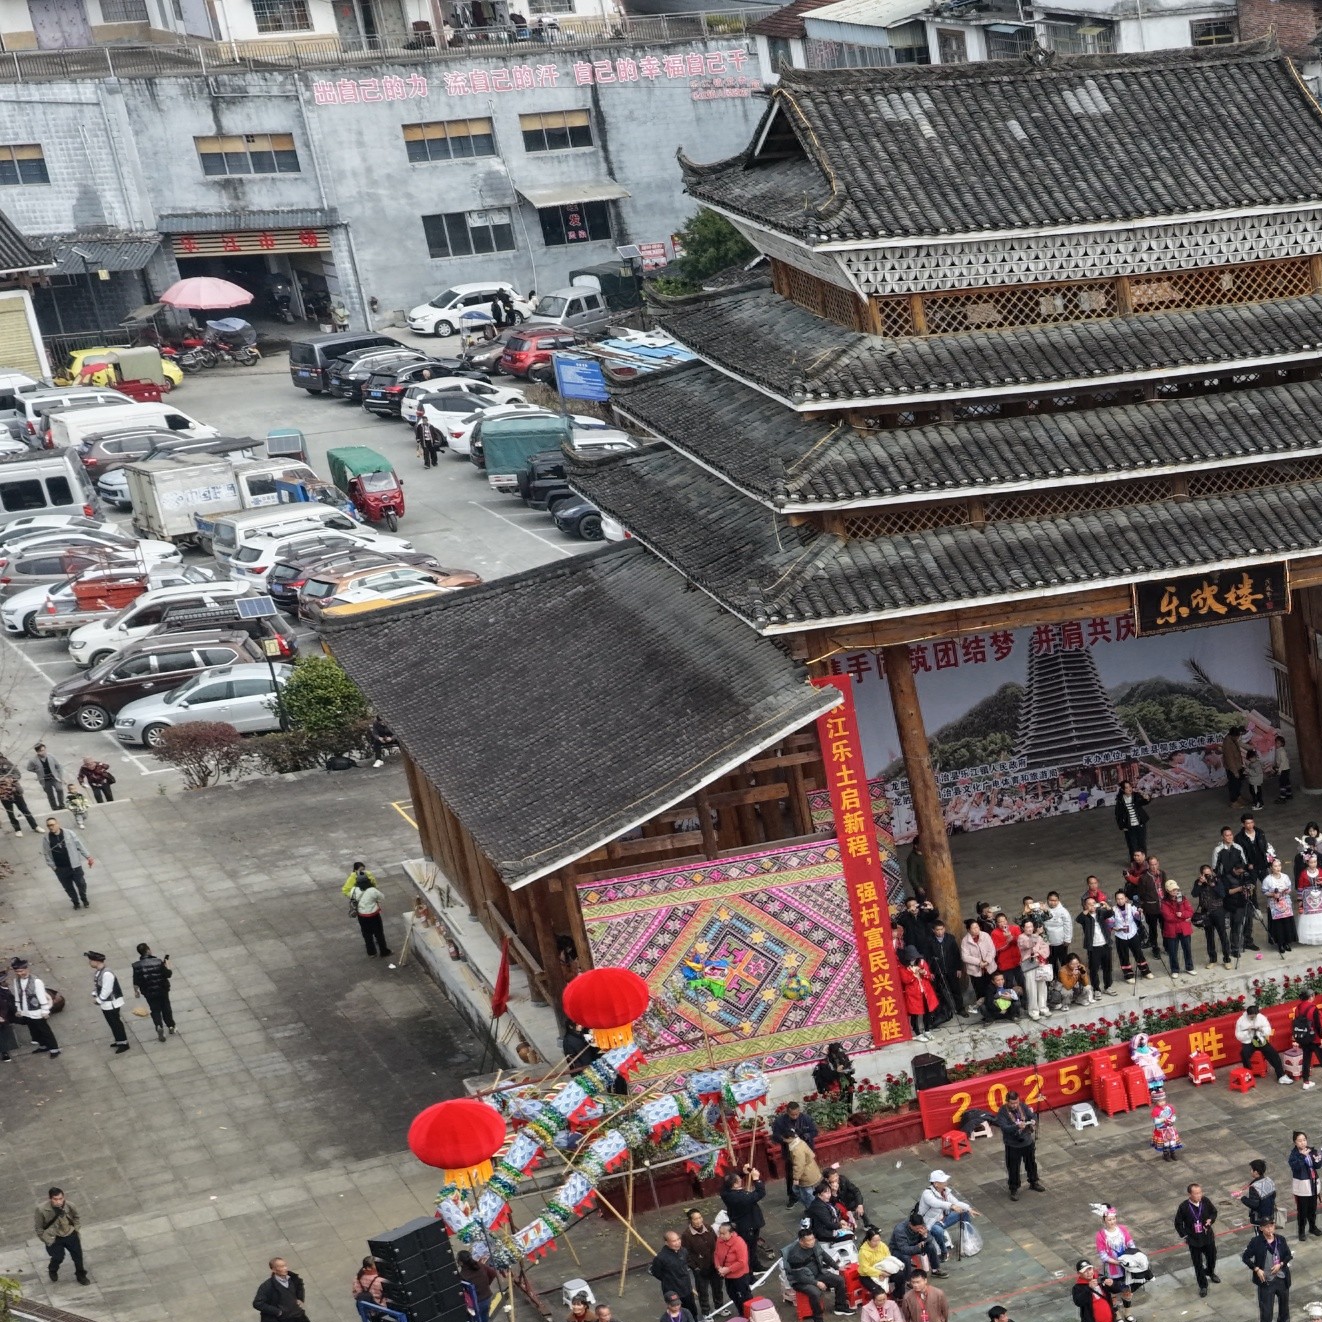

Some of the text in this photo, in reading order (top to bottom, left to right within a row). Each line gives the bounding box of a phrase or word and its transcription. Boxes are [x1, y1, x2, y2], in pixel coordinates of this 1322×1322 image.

[313, 49, 748, 105] 出自己的力 流自己的汗 自己的幸福自己干
[1156, 573, 1264, 625] 乐欣楼
